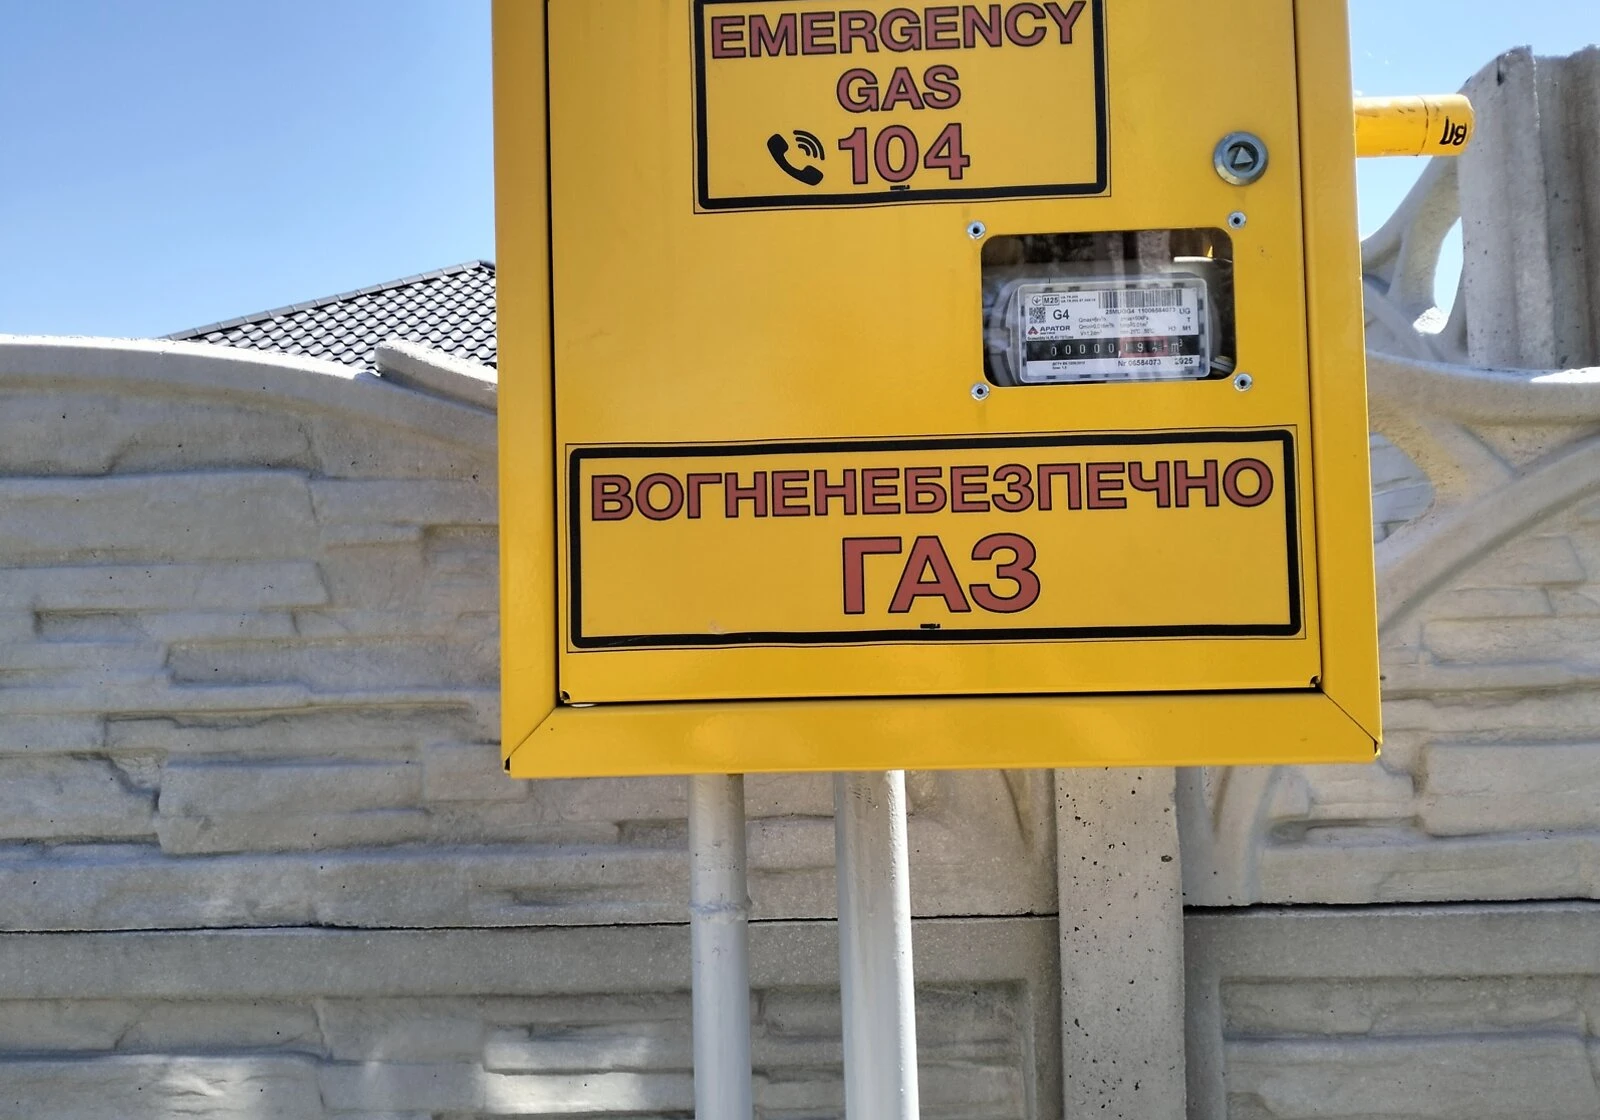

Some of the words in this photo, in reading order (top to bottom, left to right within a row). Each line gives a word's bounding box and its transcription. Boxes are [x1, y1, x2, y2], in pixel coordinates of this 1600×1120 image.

[711, 1, 1086, 59] EMERGENCY
[836, 64, 962, 113] GAS
[838, 122, 970, 185] 104
[1043, 296, 1059, 304] M25
[1053, 309, 1070, 320] G4
[1128, 359, 1162, 367] 06584073
[590, 457, 1275, 521] ВОГНЕНЕБЕЗПЕЧНО
[842, 532, 1041, 616] ГАЗ
